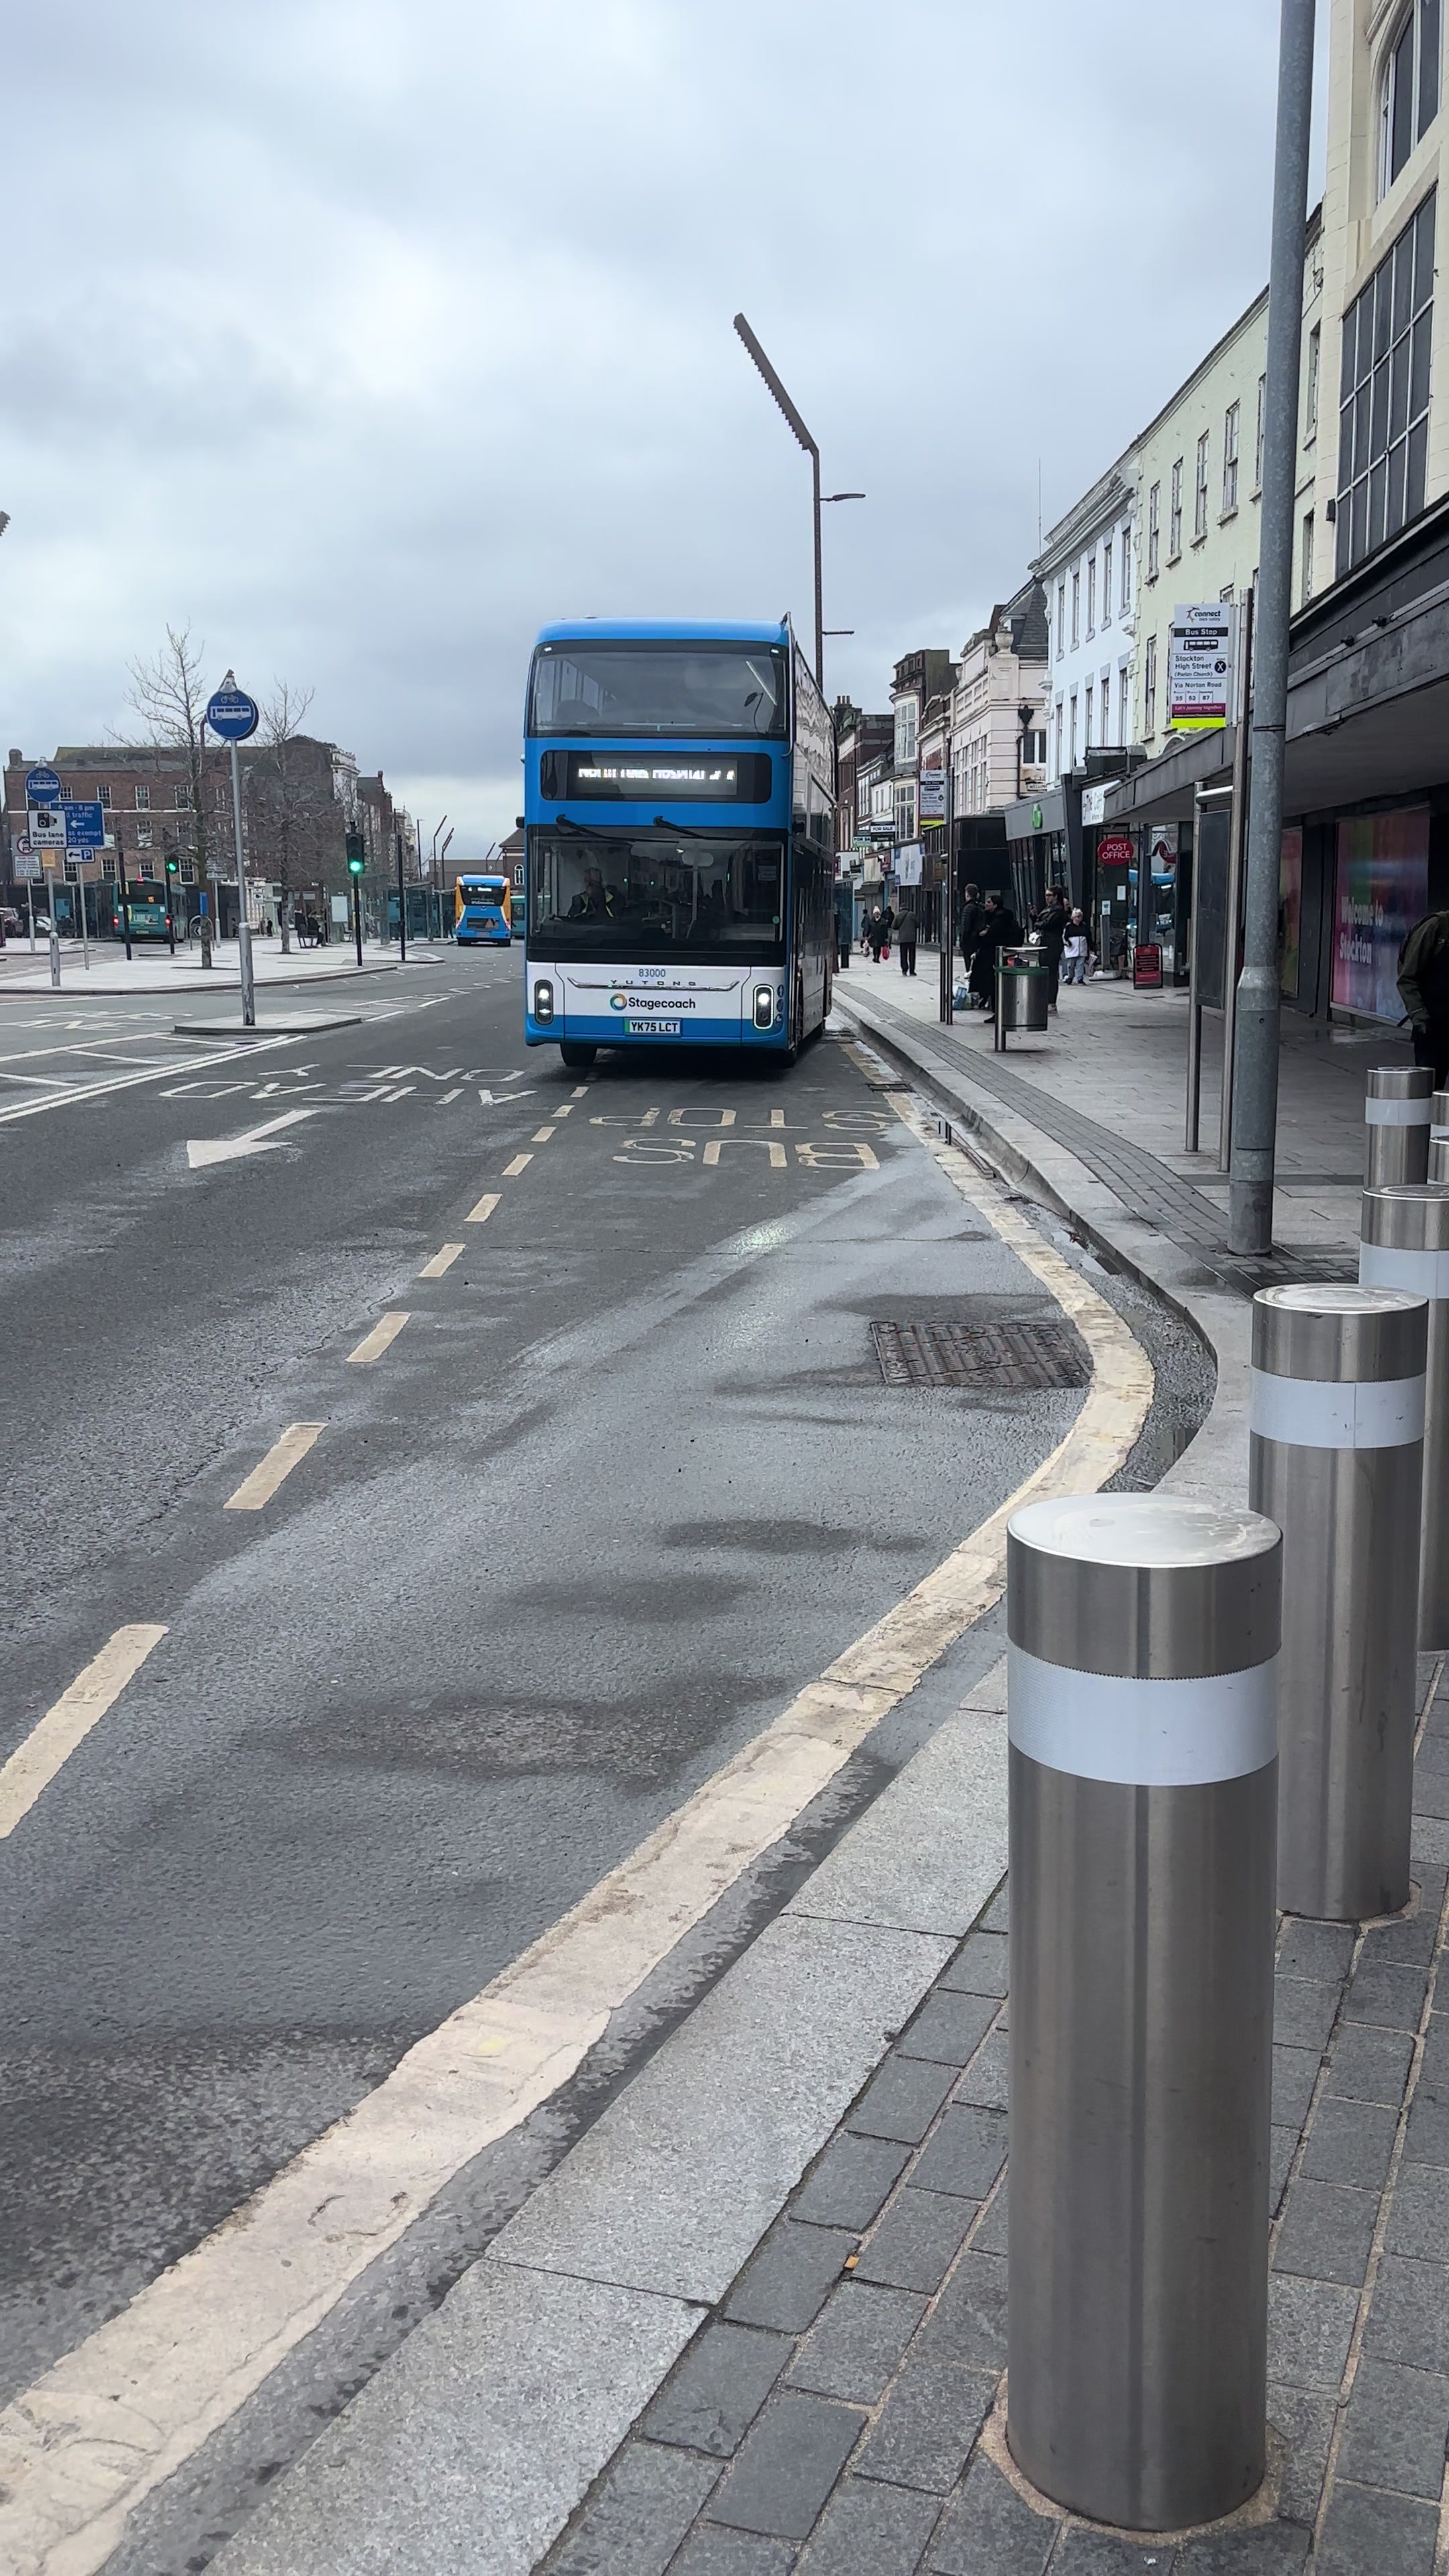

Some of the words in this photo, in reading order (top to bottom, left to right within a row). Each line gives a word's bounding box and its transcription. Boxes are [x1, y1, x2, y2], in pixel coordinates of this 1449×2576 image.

[1217, 663, 1224, 671] X
[83, 850, 91, 859] P
[1102, 851, 1130, 859] OFFICE
[1342, 896, 1373, 926] Welcome
[1375, 899, 1383, 927] to
[1339, 932, 1372, 964] Stockton
[639, 969, 666, 977] 83000
[629, 997, 696, 1010] Stagecoach
[0, 1019, 156, 1031] ANE
[631, 1022, 656, 1032] YK75
[659, 1022, 678, 1032] LCT
[258, 1064, 525, 1082] ONLY
[158, 1081, 538, 1105] AHEAD
[588, 1107, 900, 1131] STOP
[612, 1138, 881, 1169] BUS
